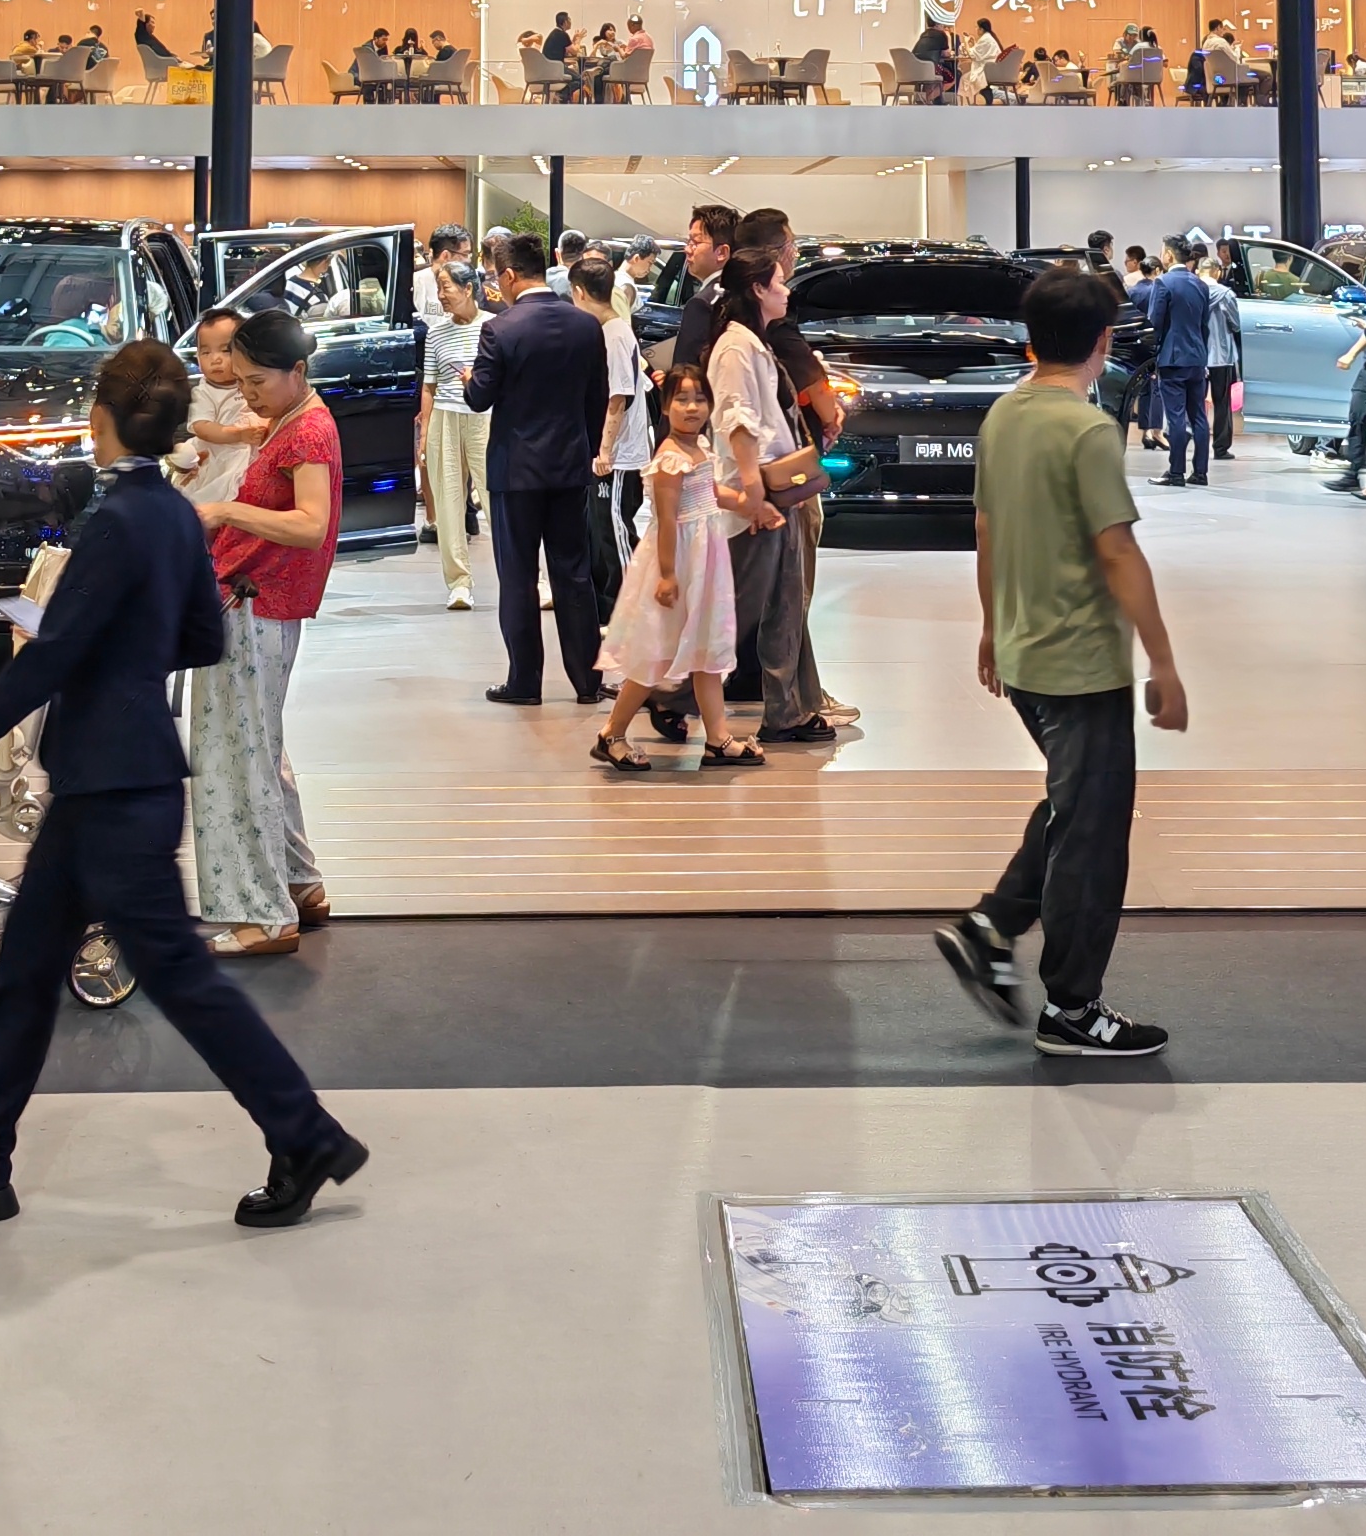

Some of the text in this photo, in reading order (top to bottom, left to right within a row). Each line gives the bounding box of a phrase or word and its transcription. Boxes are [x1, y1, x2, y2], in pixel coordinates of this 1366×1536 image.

[915, 443, 974, 458] 问界 M6
[1048, 1350, 1109, 1422] HYDRANT
[1086, 1320, 1217, 1421] 消防栓
